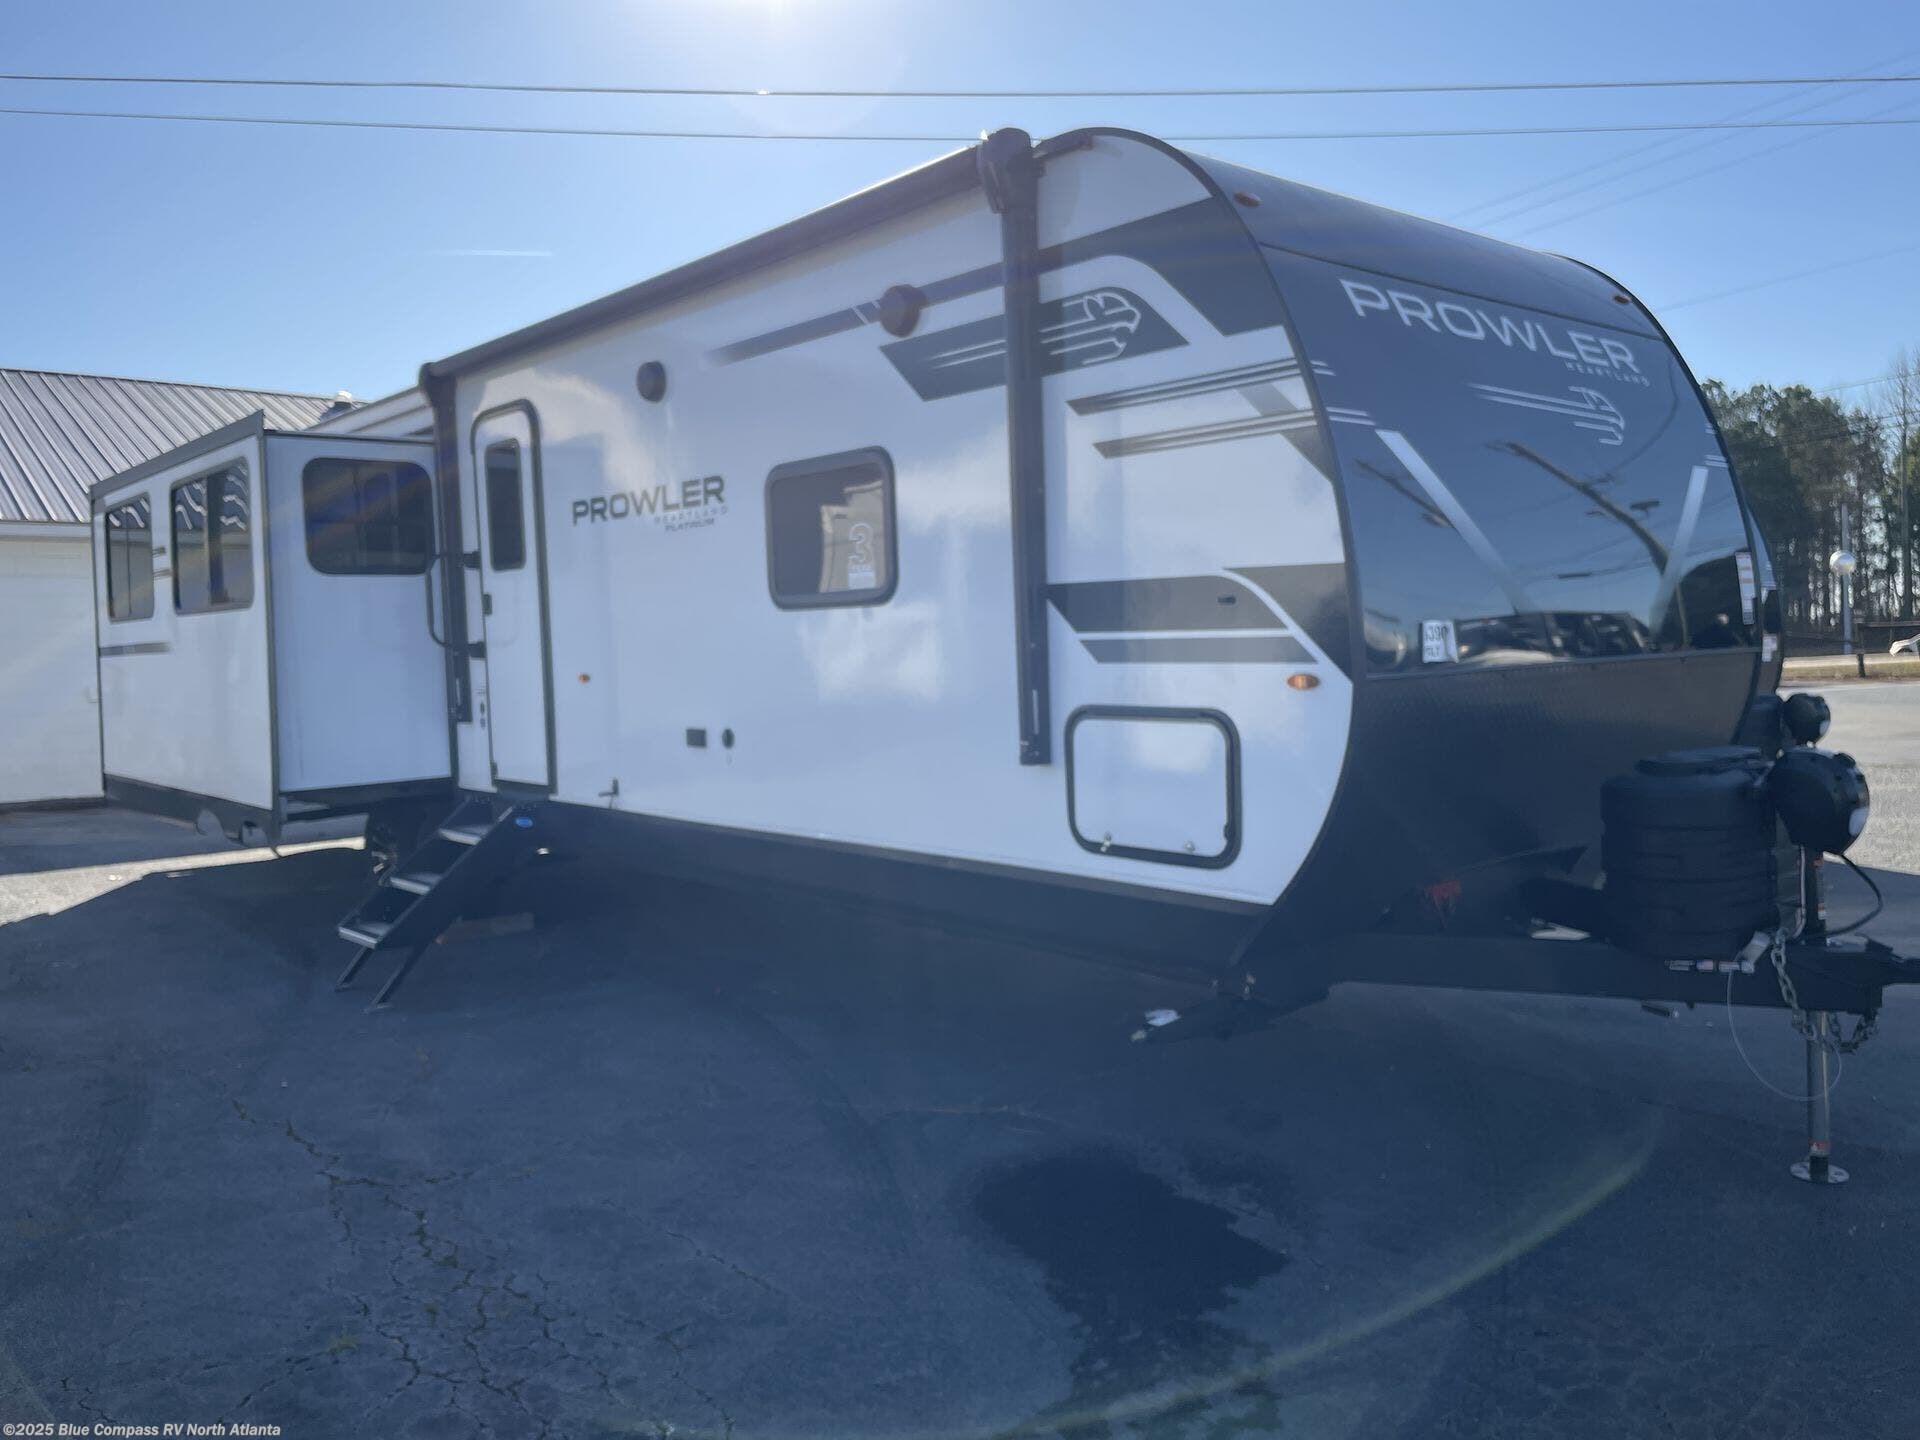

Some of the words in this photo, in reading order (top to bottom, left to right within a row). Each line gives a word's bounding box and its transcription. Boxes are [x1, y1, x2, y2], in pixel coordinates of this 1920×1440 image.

[1338, 279, 1641, 374] PROWLER
[1564, 361, 1650, 387] HEARTLAND
[572, 475, 725, 527] PROWLER
[665, 518, 715, 532] PLATINUM
